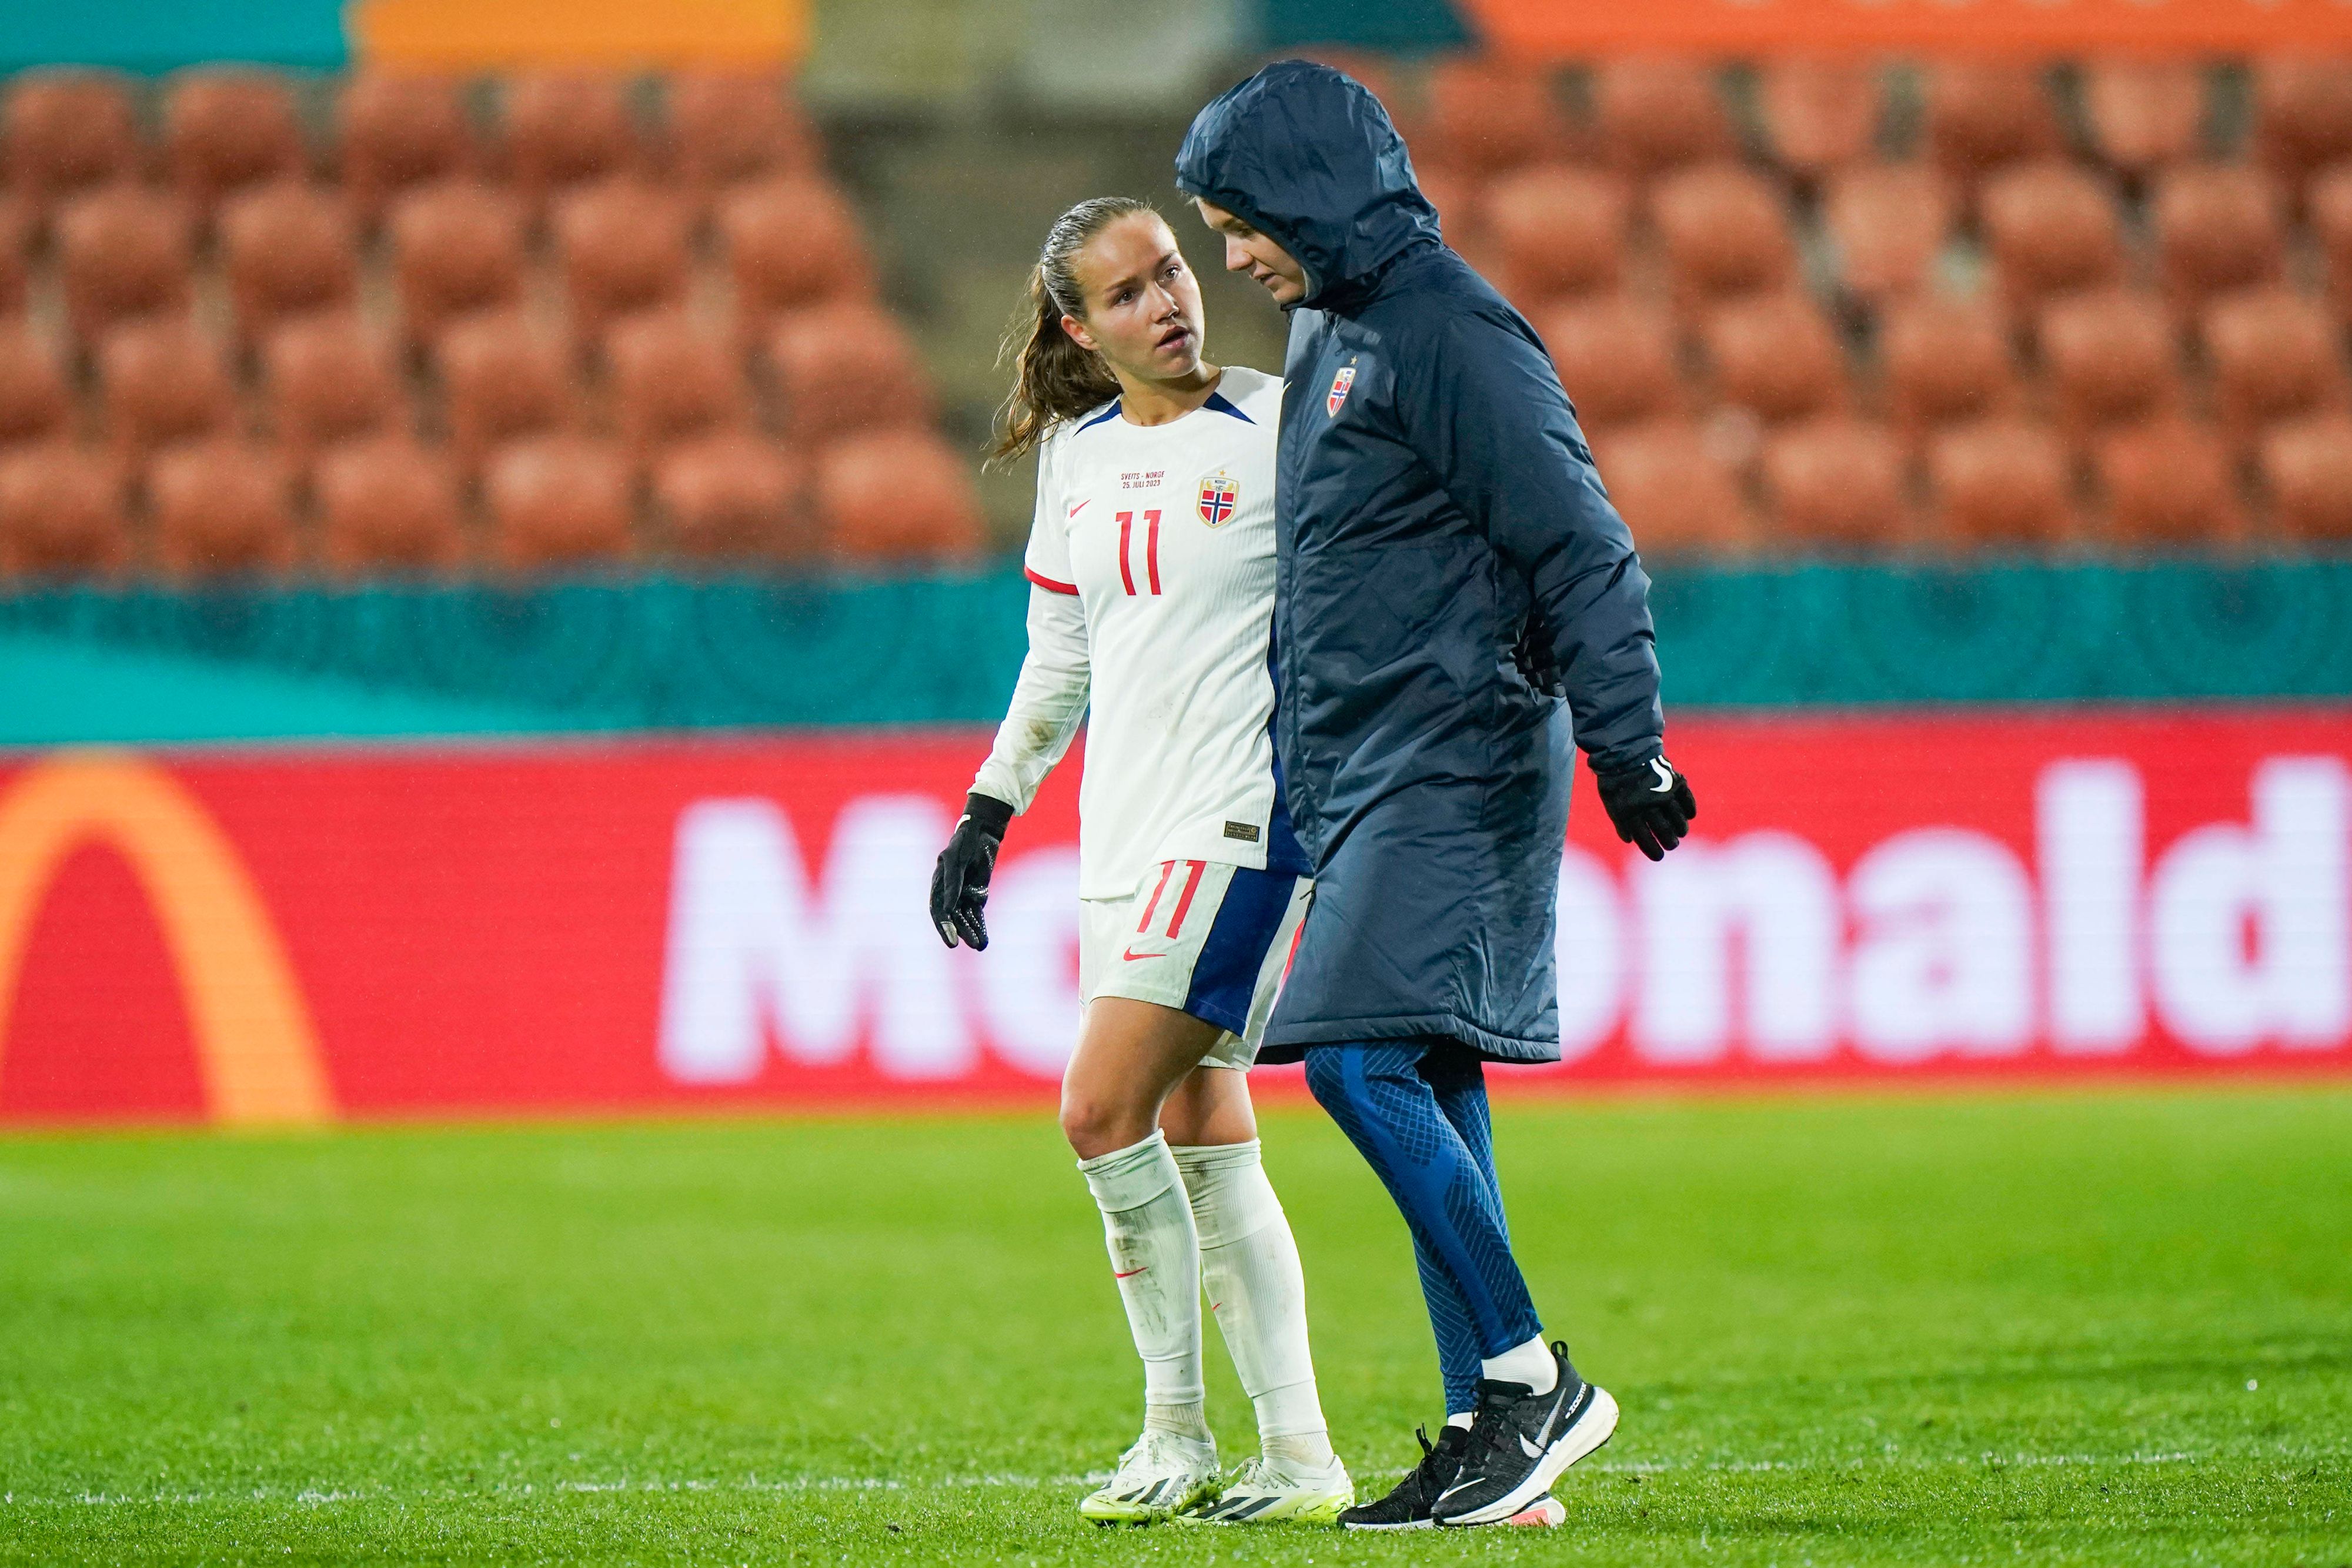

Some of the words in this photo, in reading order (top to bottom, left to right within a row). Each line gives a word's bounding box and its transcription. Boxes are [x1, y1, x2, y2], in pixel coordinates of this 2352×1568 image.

[1145, 471, 1165, 479] NORGE
[1115, 510, 1162, 596] 11
[657, 754, 2348, 1083] Mcnald
[1137, 860, 1207, 940] 11
